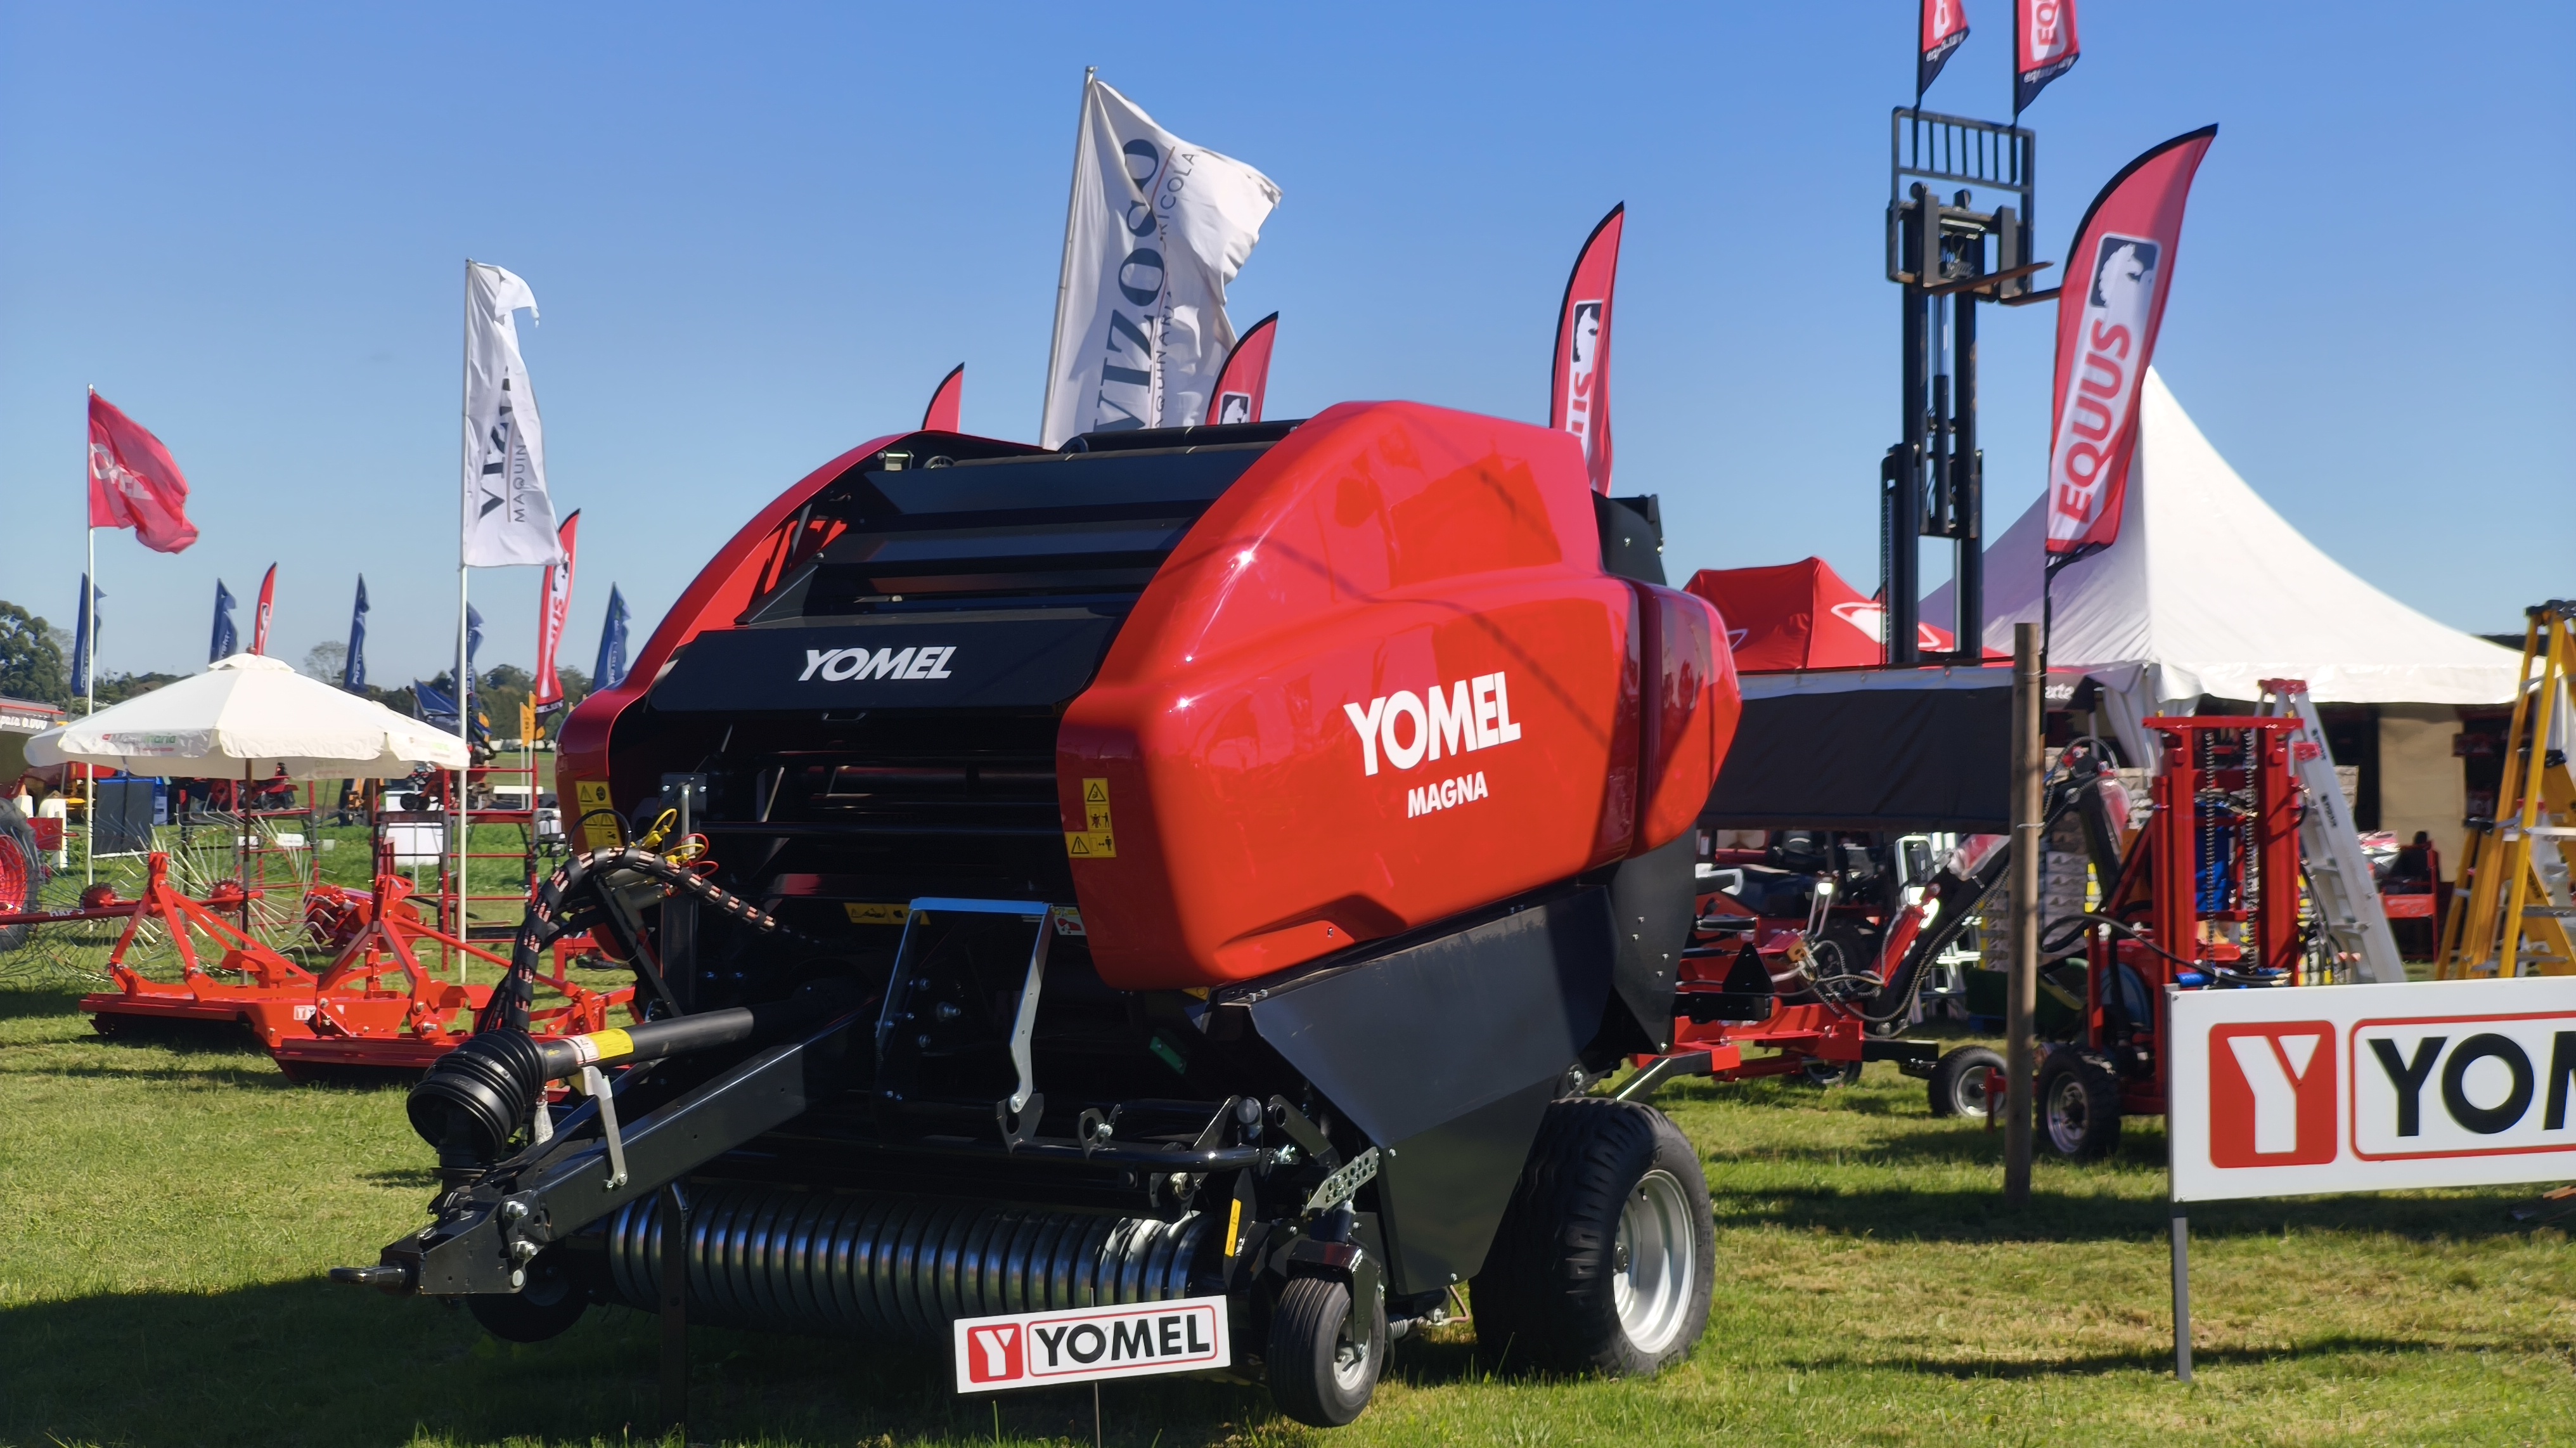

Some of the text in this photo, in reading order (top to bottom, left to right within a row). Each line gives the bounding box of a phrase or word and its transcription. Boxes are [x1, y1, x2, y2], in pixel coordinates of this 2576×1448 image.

[2058, 318, 2132, 524] EQUUS
[797, 646, 957, 682] YOMEL
[1343, 671, 1521, 777] YOMEL
[1408, 771, 1488, 818] MAGNA
[1034, 1314, 1211, 1367] YOMEL
